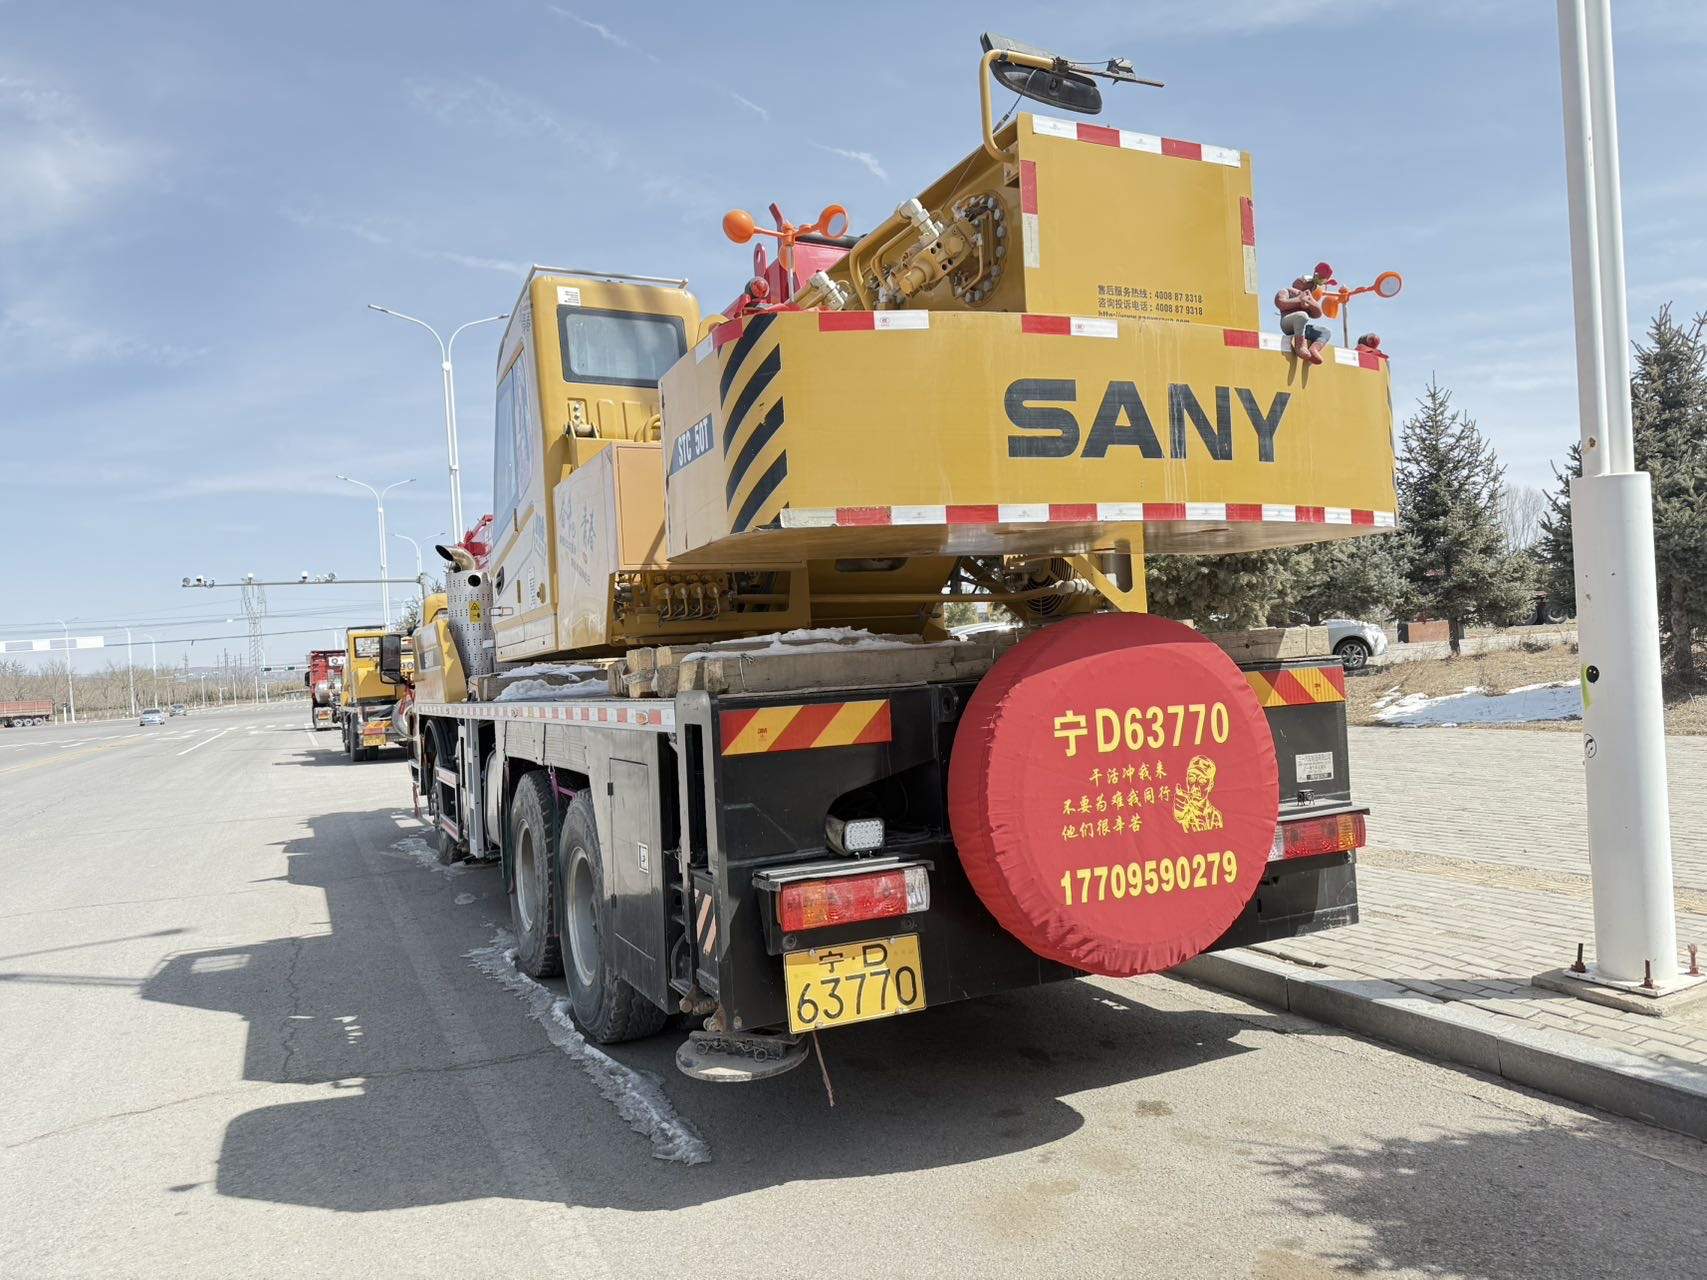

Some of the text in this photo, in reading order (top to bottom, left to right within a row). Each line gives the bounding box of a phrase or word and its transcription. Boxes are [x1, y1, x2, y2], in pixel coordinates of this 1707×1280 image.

[1154, 290, 1173, 301] 4008
[1174, 292, 1183, 302] 87
[1155, 303, 1173, 314] 4008
[1175, 304, 1184, 314] 87
[1185, 304, 1203, 316] 9318
[1004, 378, 1291, 463] SANY
[1053, 702, 1230, 757] 宁D63770
[1089, 760, 1168, 787] 干活冲我来
[1062, 785, 1171, 815] 不要为难我同行
[1061, 813, 1143, 841] 他们很辛苦
[1060, 850, 1238, 906] 17709590279
[796, 965, 918, 1024] 63770
